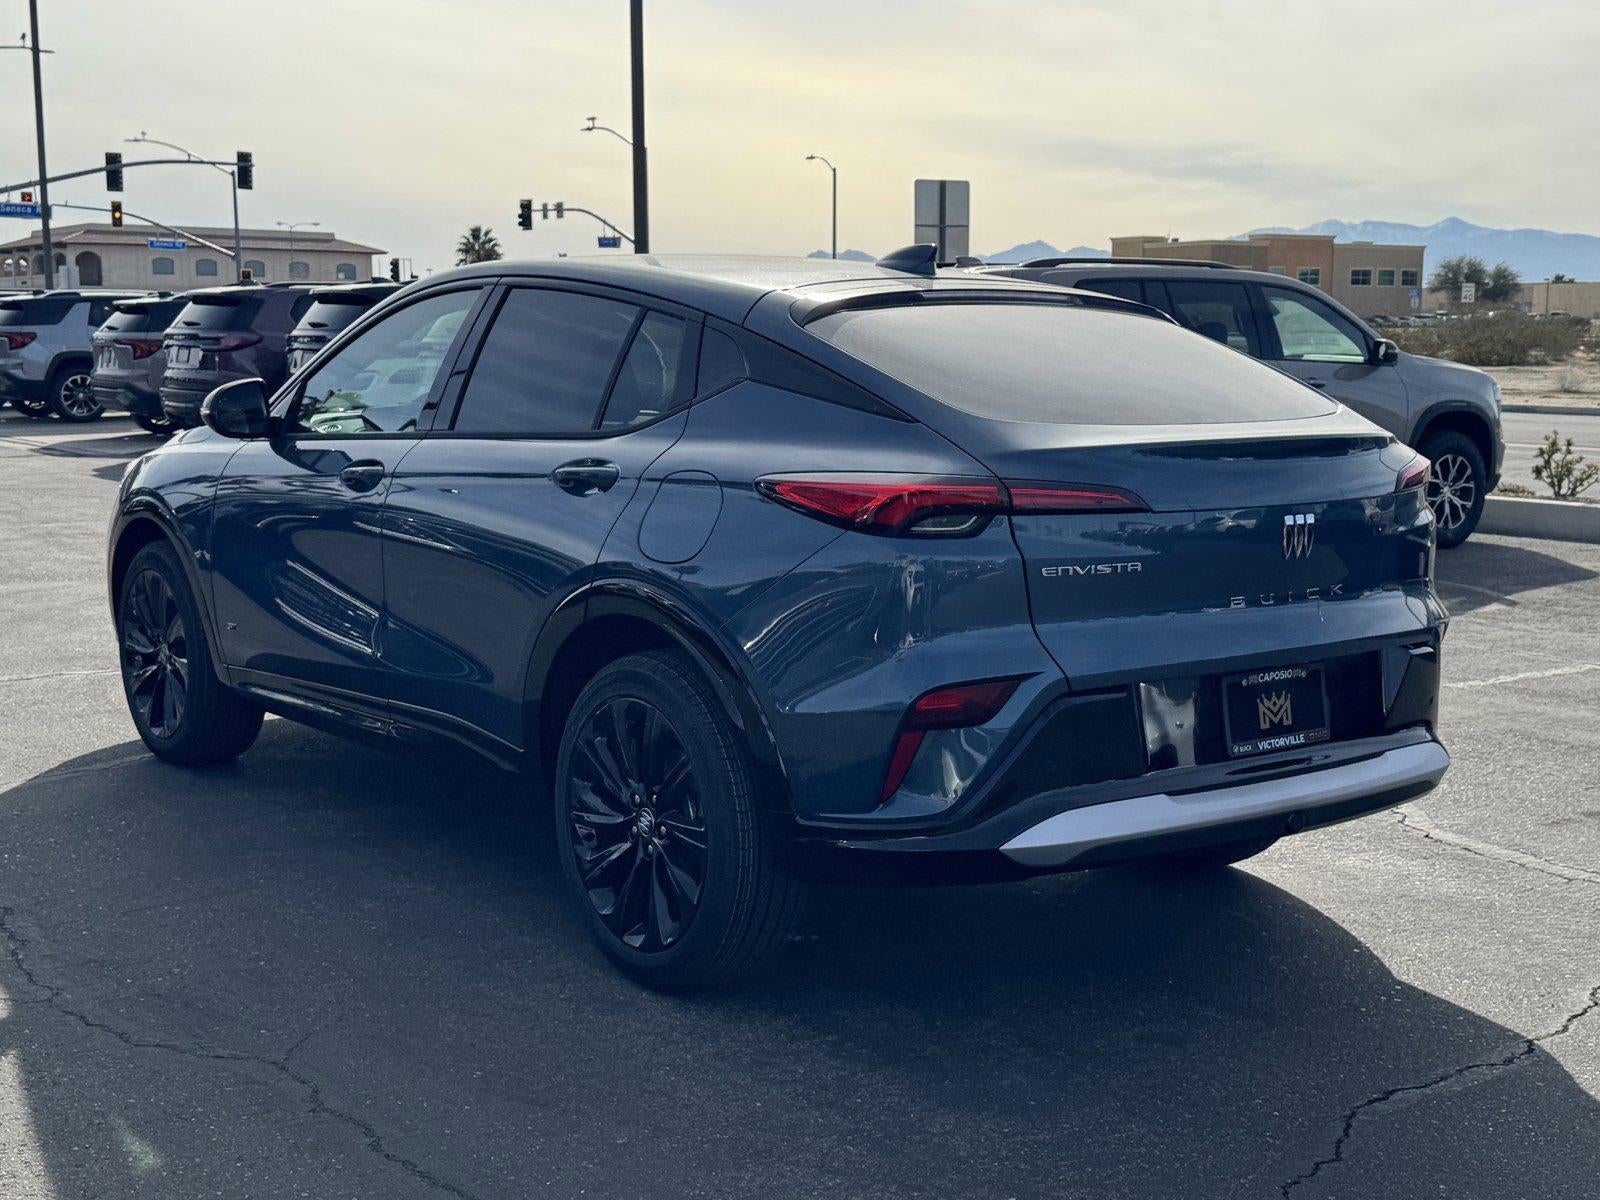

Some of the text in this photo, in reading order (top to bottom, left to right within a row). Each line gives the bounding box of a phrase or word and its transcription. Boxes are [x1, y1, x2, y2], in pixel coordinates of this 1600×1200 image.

[0, 203, 32, 214] Seneca
[1041, 562, 1143, 577] ENVISTA
[1229, 583, 1343, 609] BUICK
[1258, 669, 1293, 683] CAPOSIO
[1257, 733, 1306, 750] VICTORVILLE
